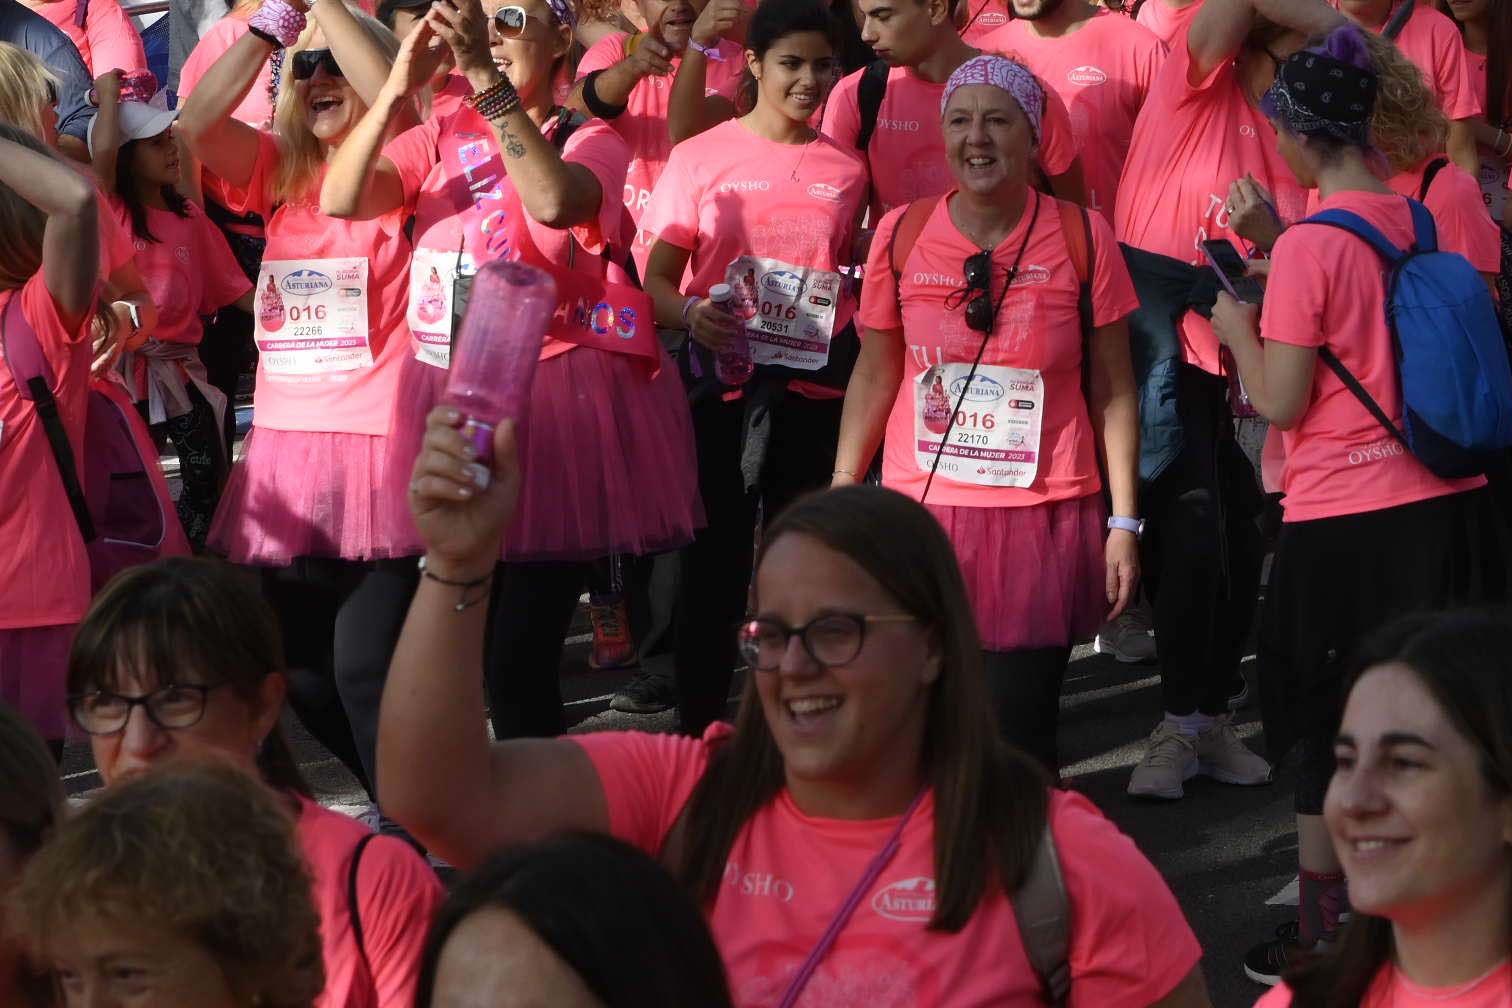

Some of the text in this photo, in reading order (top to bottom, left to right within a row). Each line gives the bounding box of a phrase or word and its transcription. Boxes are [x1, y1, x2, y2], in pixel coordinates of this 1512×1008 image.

[284, 277, 330, 291] ASTURIANA
[289, 304, 328, 321] 016
[761, 300, 797, 320] 016
[293, 324, 323, 336] 22266
[760, 320, 789, 334] 20531
[1009, 383, 1036, 392] SUMA
[956, 410, 996, 429] 016
[957, 432, 989, 445] 22170
[1348, 444, 1405, 466] OYSHO
